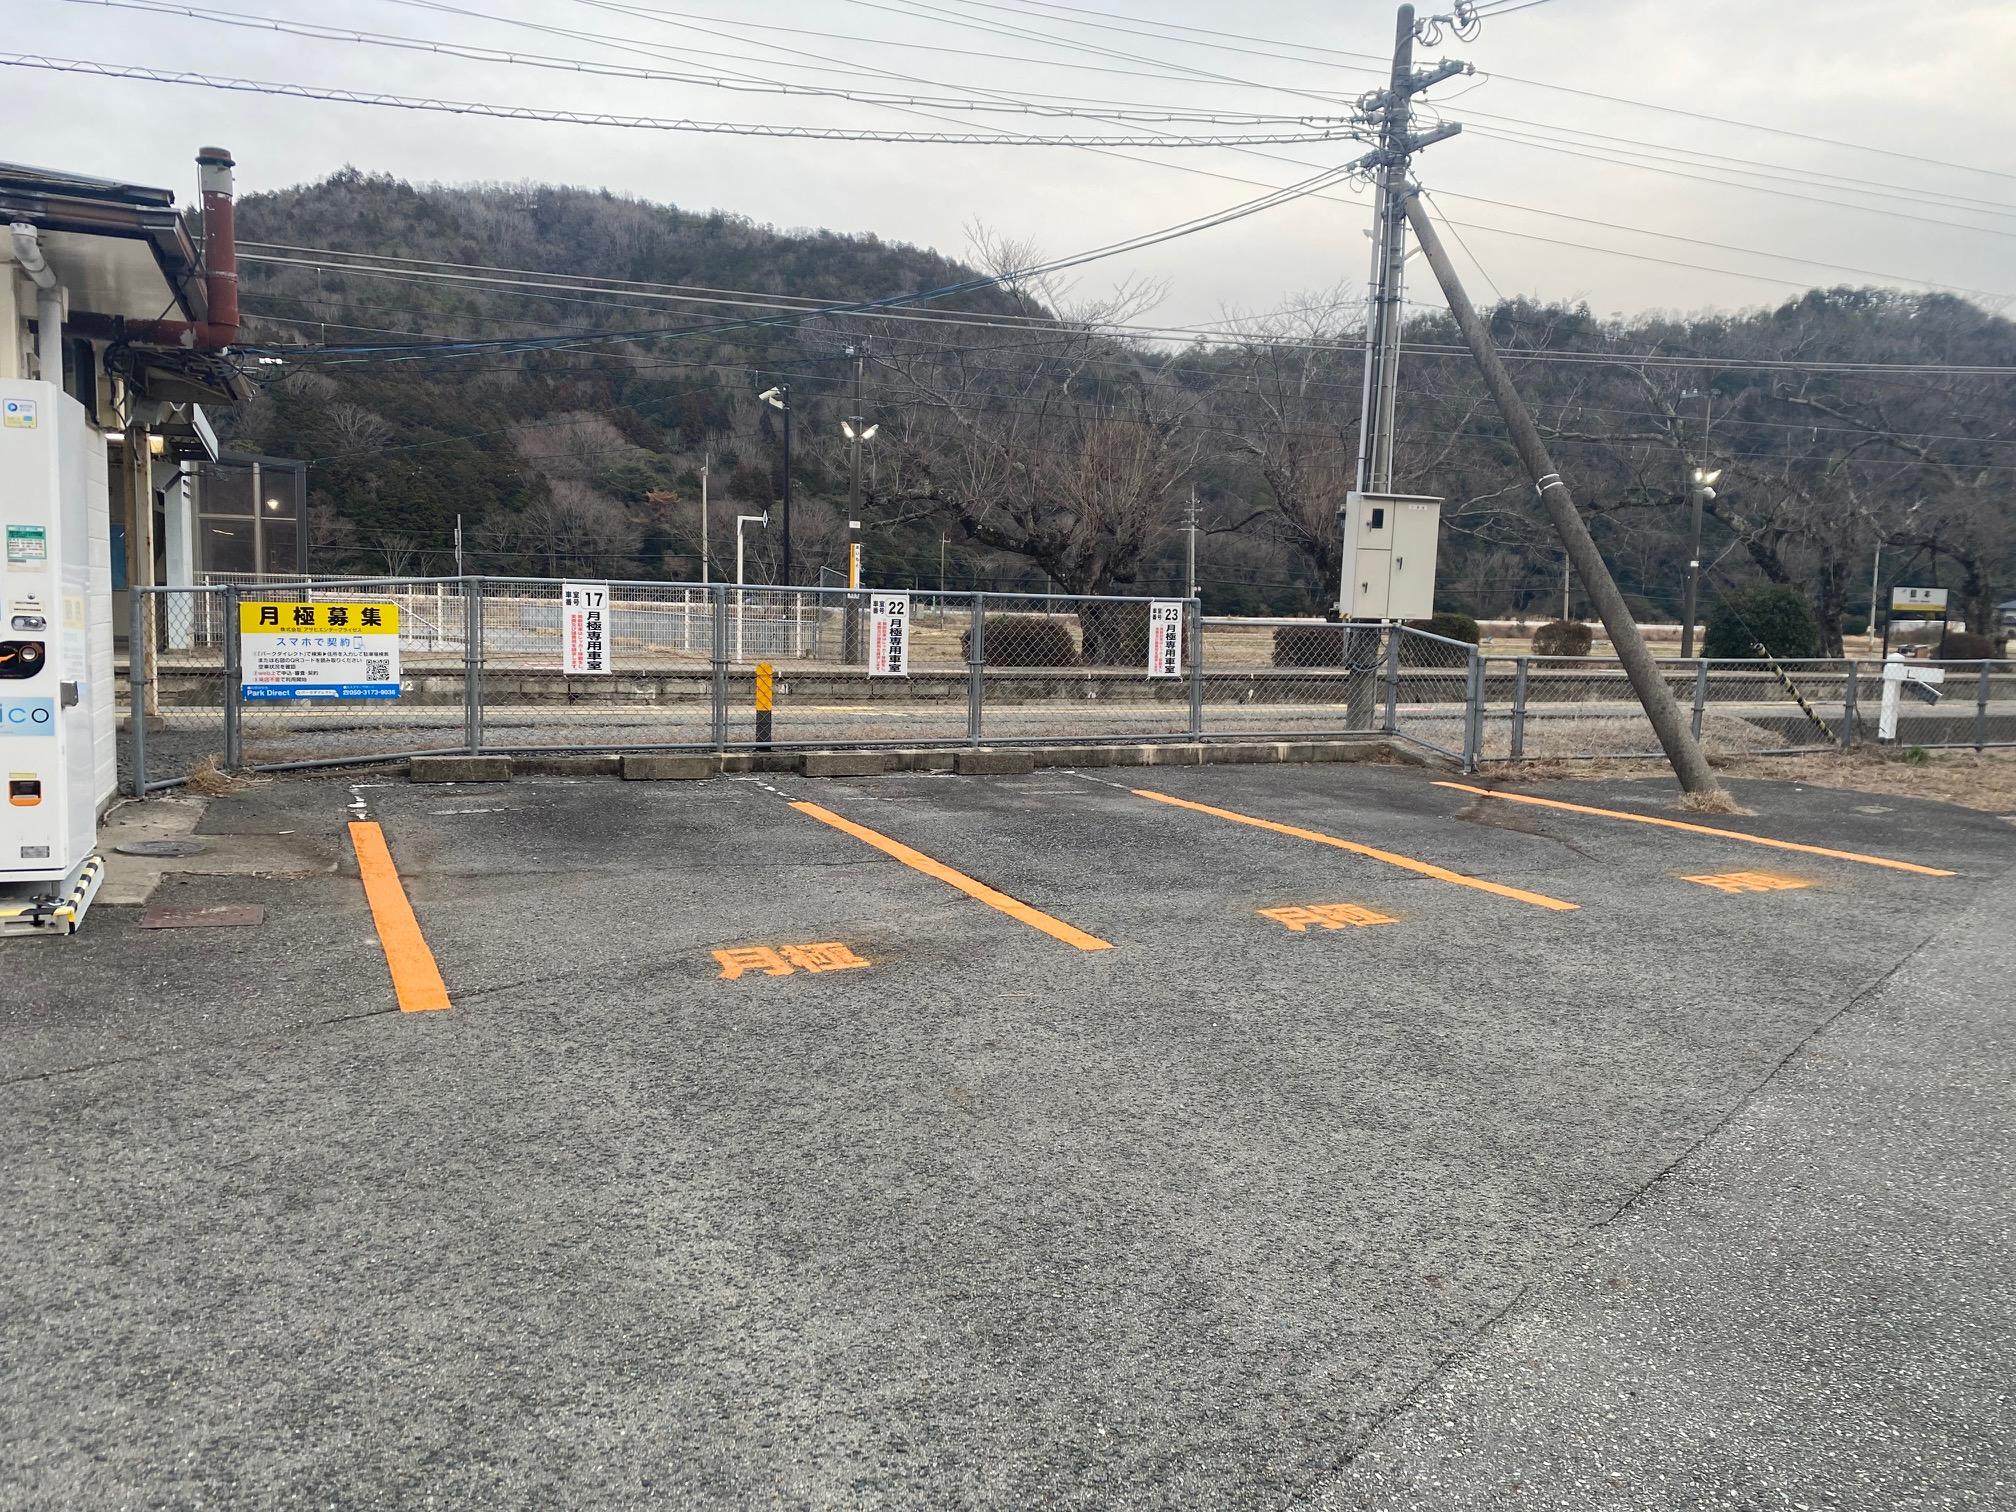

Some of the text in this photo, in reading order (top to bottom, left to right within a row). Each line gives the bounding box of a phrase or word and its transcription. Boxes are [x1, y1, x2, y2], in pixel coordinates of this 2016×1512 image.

[585, 592, 603, 607] 17
[888, 601, 904, 615] 22
[259, 606, 382, 627] 月極募集
[1165, 608, 1178, 621] 23
[276, 637, 351, 647] スマホで契約
[586, 611, 603, 671] 月極専用車室
[888, 618, 903, 672] 月極専用車室
[1164, 624, 1176, 674] 月極専用車室
[246, 689, 291, 697] Park Direct
[1256, 903, 1400, 931] 月極
[711, 942, 872, 981] 月極
